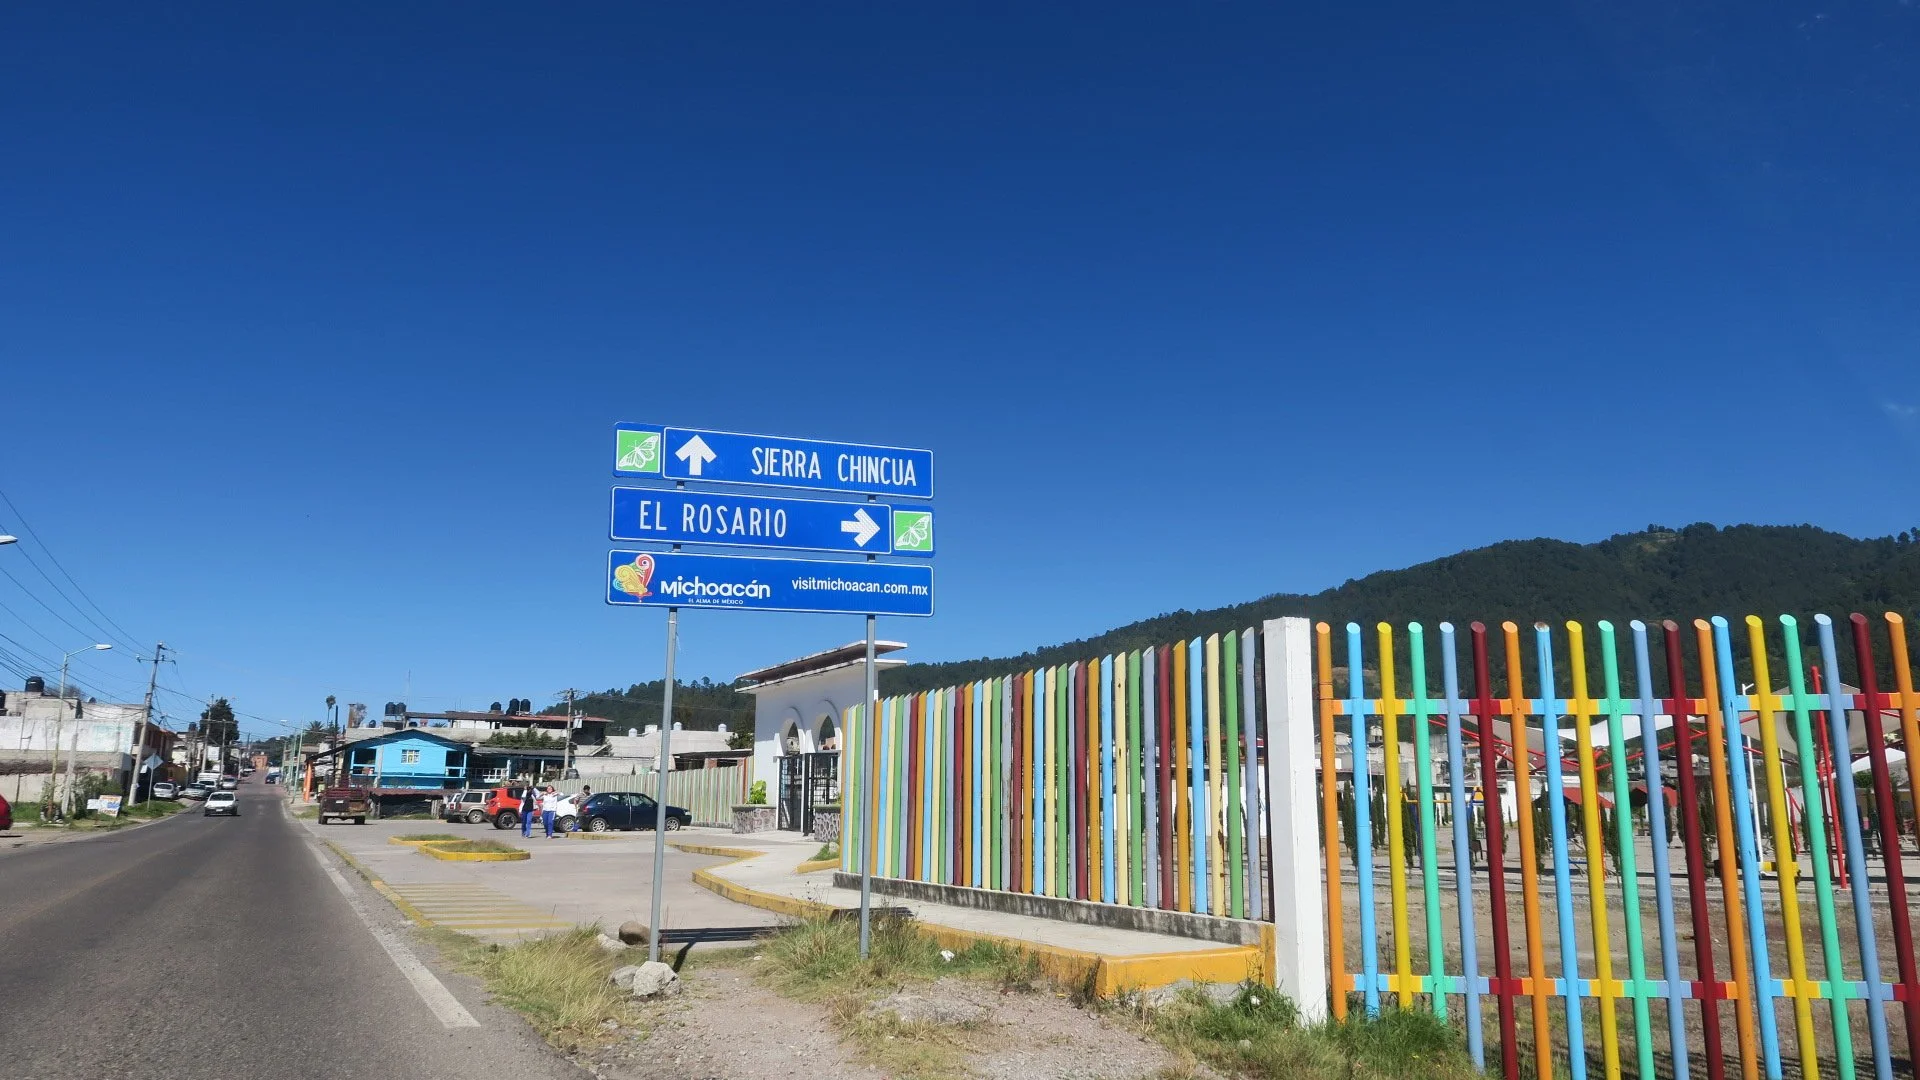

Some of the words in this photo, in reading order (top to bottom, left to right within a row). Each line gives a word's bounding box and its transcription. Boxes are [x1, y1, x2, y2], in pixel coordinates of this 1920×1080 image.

[752, 447, 821, 479] SIERRA
[838, 454, 916, 486] CHINCUA
[640, 501, 667, 530] EL
[682, 503, 787, 538] ROSARIO
[660, 575, 771, 600] Michoacán
[792, 577, 928, 596] visitmichoacan.com.mx
